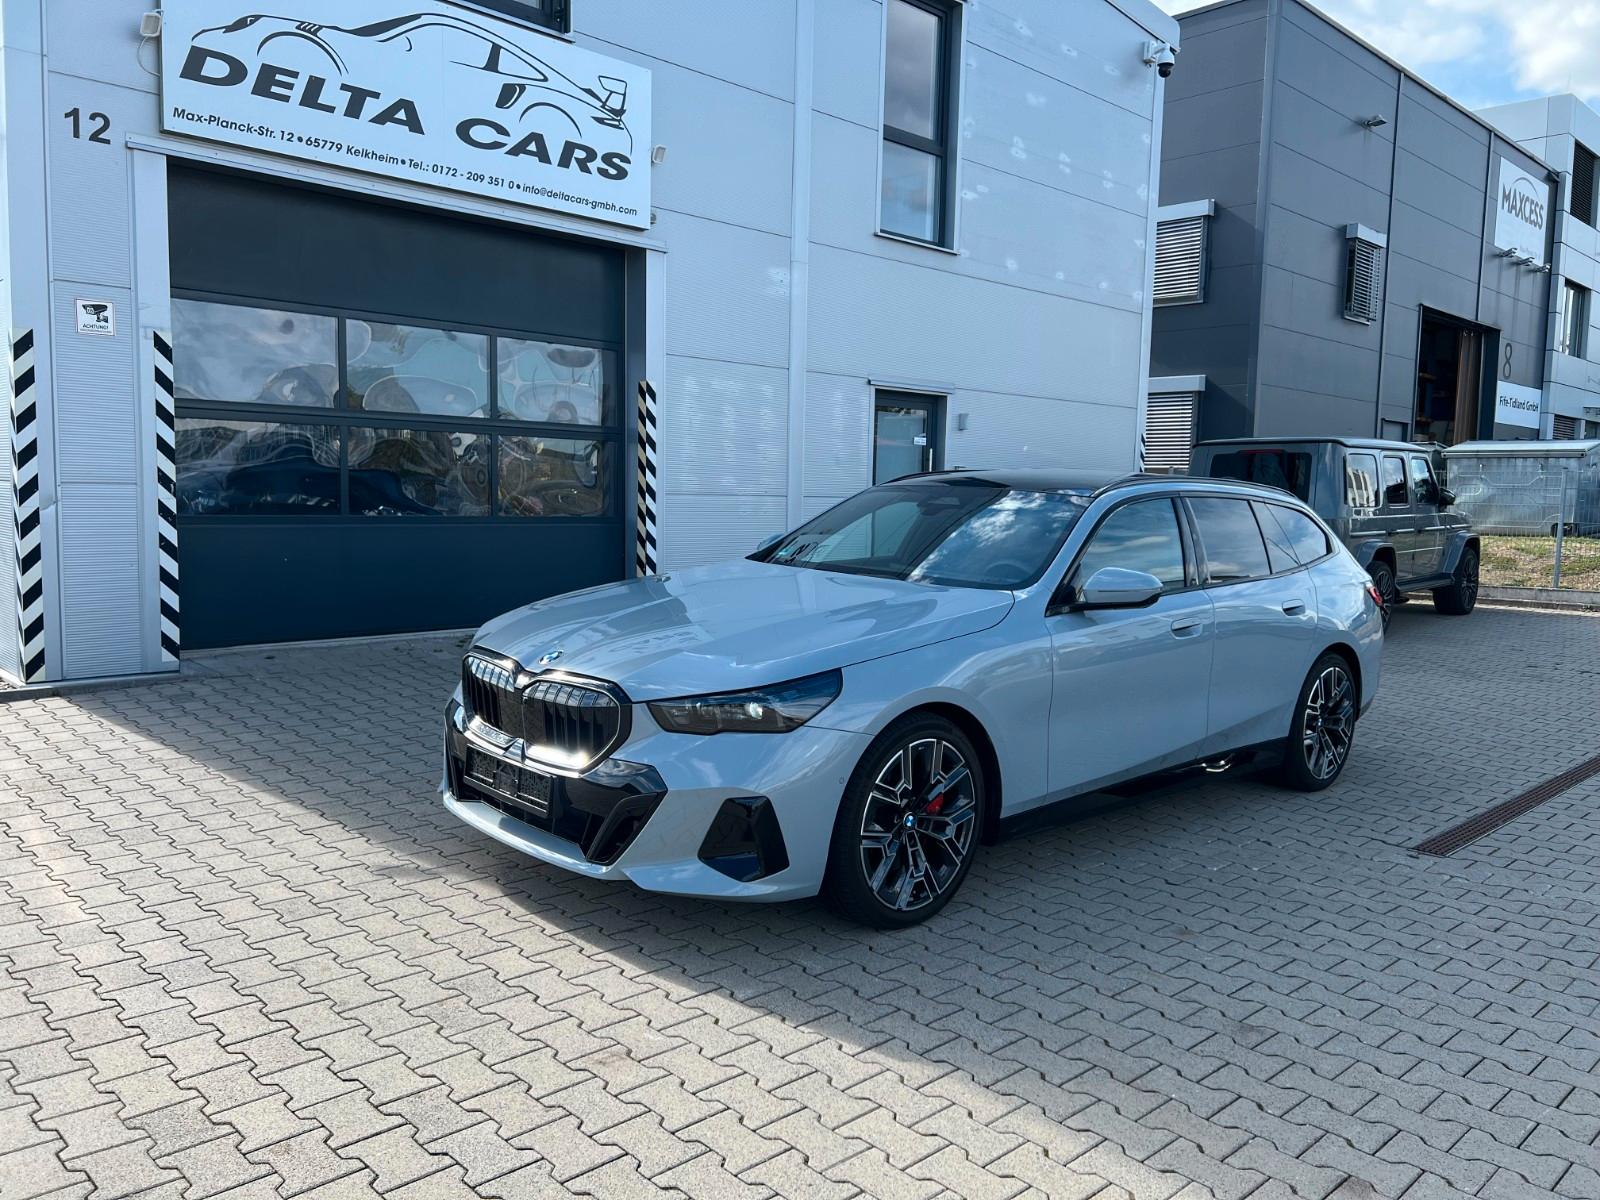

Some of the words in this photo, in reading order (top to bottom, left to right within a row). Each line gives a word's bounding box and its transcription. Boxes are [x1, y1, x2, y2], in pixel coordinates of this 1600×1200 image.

[64, 107, 111, 145] 12
[179, 45, 425, 135] DELTA
[455, 118, 631, 181] CARS
[172, 107, 276, 139] Max-Planck-Str.
[279, 130, 294, 143] 12
[305, 136, 343, 152] 65779
[346, 145, 399, 165] Kelkheim
[408, 158, 429, 172] Tel.:
[432, 163, 458, 177] 0172
[466, 171, 485, 184] 209
[487, 175, 505, 188] 351
[522, 184, 638, 216] info@deltacars-gmbh.com
[1501, 183, 1544, 230] MAXCESS
[1503, 342, 1513, 379] 8
[1526, 400, 1539, 413] GmbH
